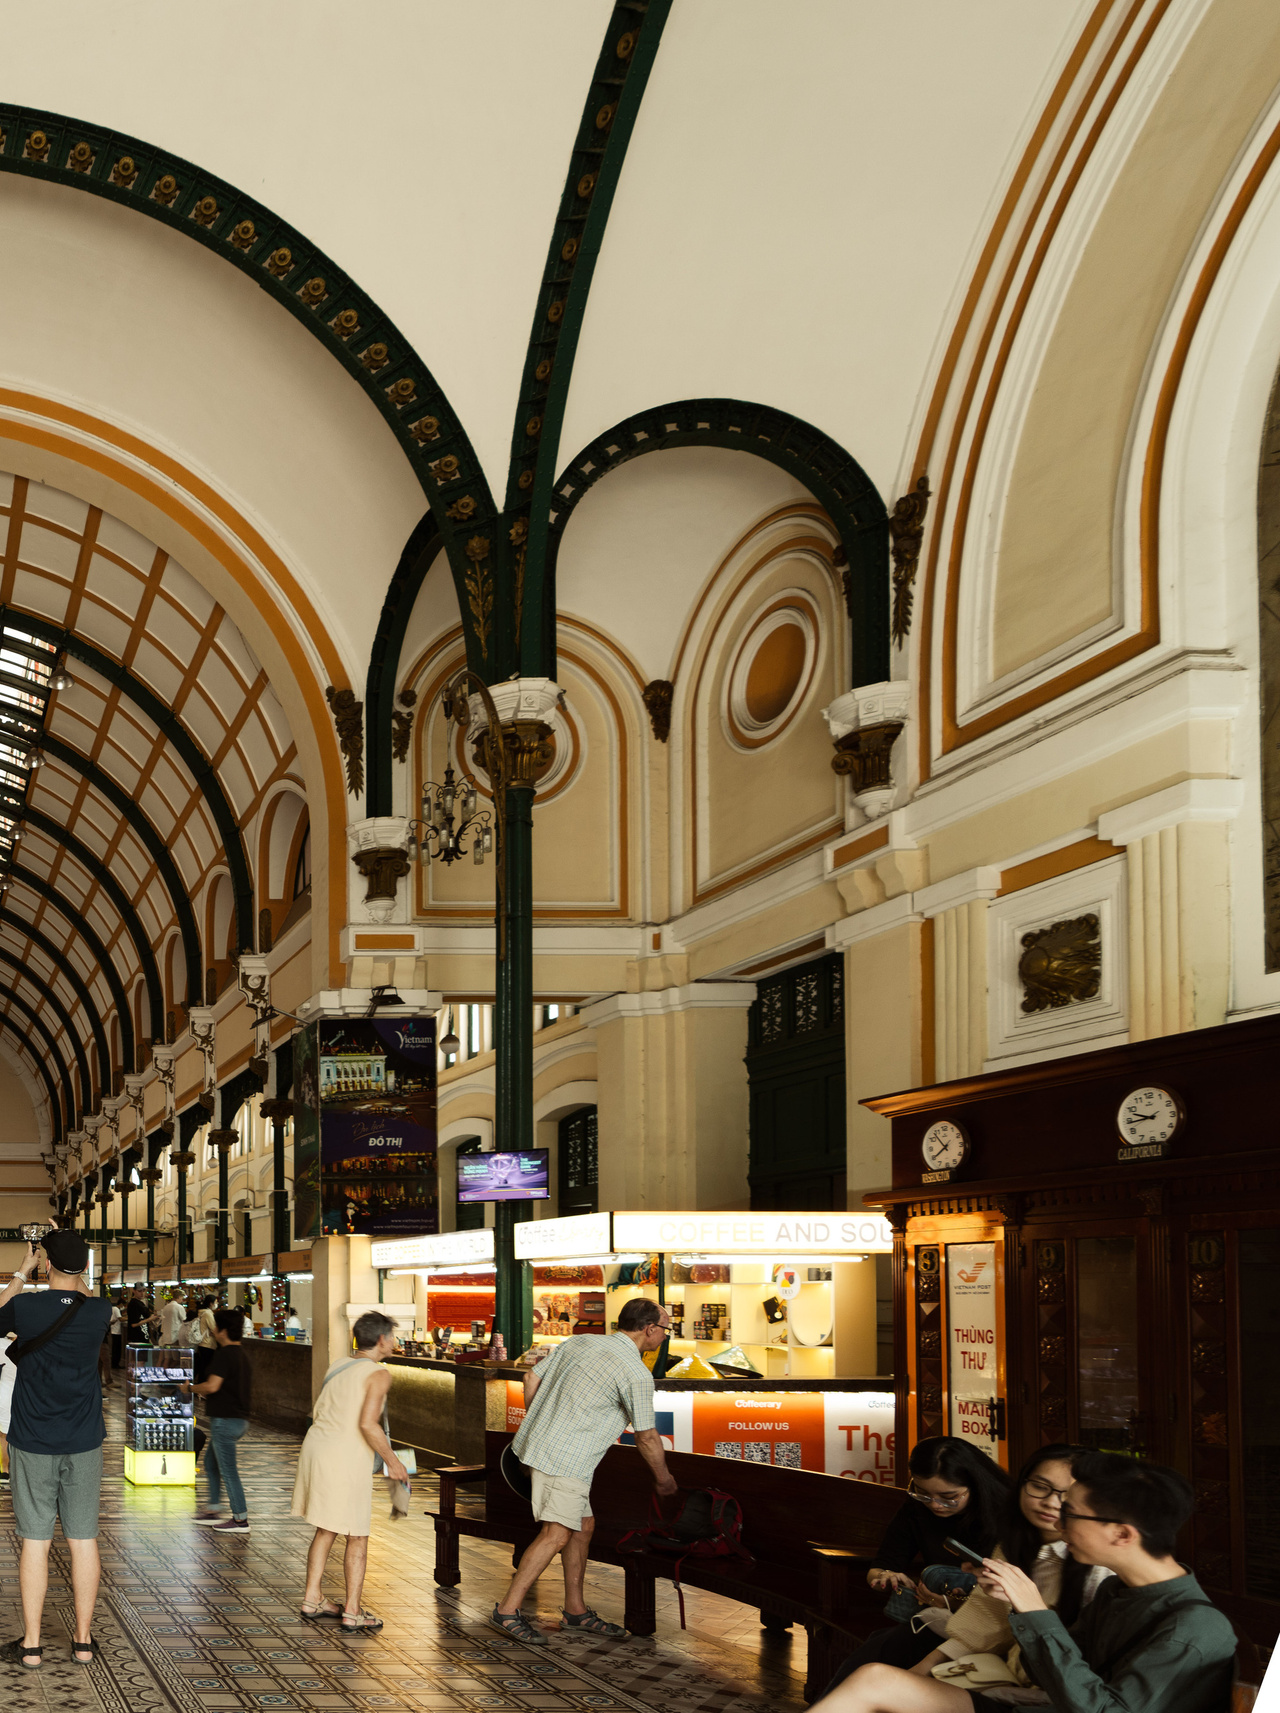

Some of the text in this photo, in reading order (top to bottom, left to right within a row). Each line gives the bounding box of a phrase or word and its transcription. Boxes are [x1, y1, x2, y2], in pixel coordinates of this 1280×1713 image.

[394, 1030, 432, 1049] Vietnam
[368, 1136, 402, 1148] ĐÔ THỊ
[1118, 1144, 1162, 1160] CALIFORNIA
[660, 1222, 764, 1242] COFFEE
[776, 1222, 830, 1242] AND
[1040, 1246, 1055, 1269] 9
[1189, 1240, 1217, 1264] 10
[954, 1325, 994, 1344] THÙNG
[960, 1351, 987, 1370] THƯ
[735, 1400, 782, 1409] Coffeerary
[728, 1422, 789, 1430] FOLLOW US
[961, 1420, 989, 1436] BOX
[838, 1425, 896, 1452] The
